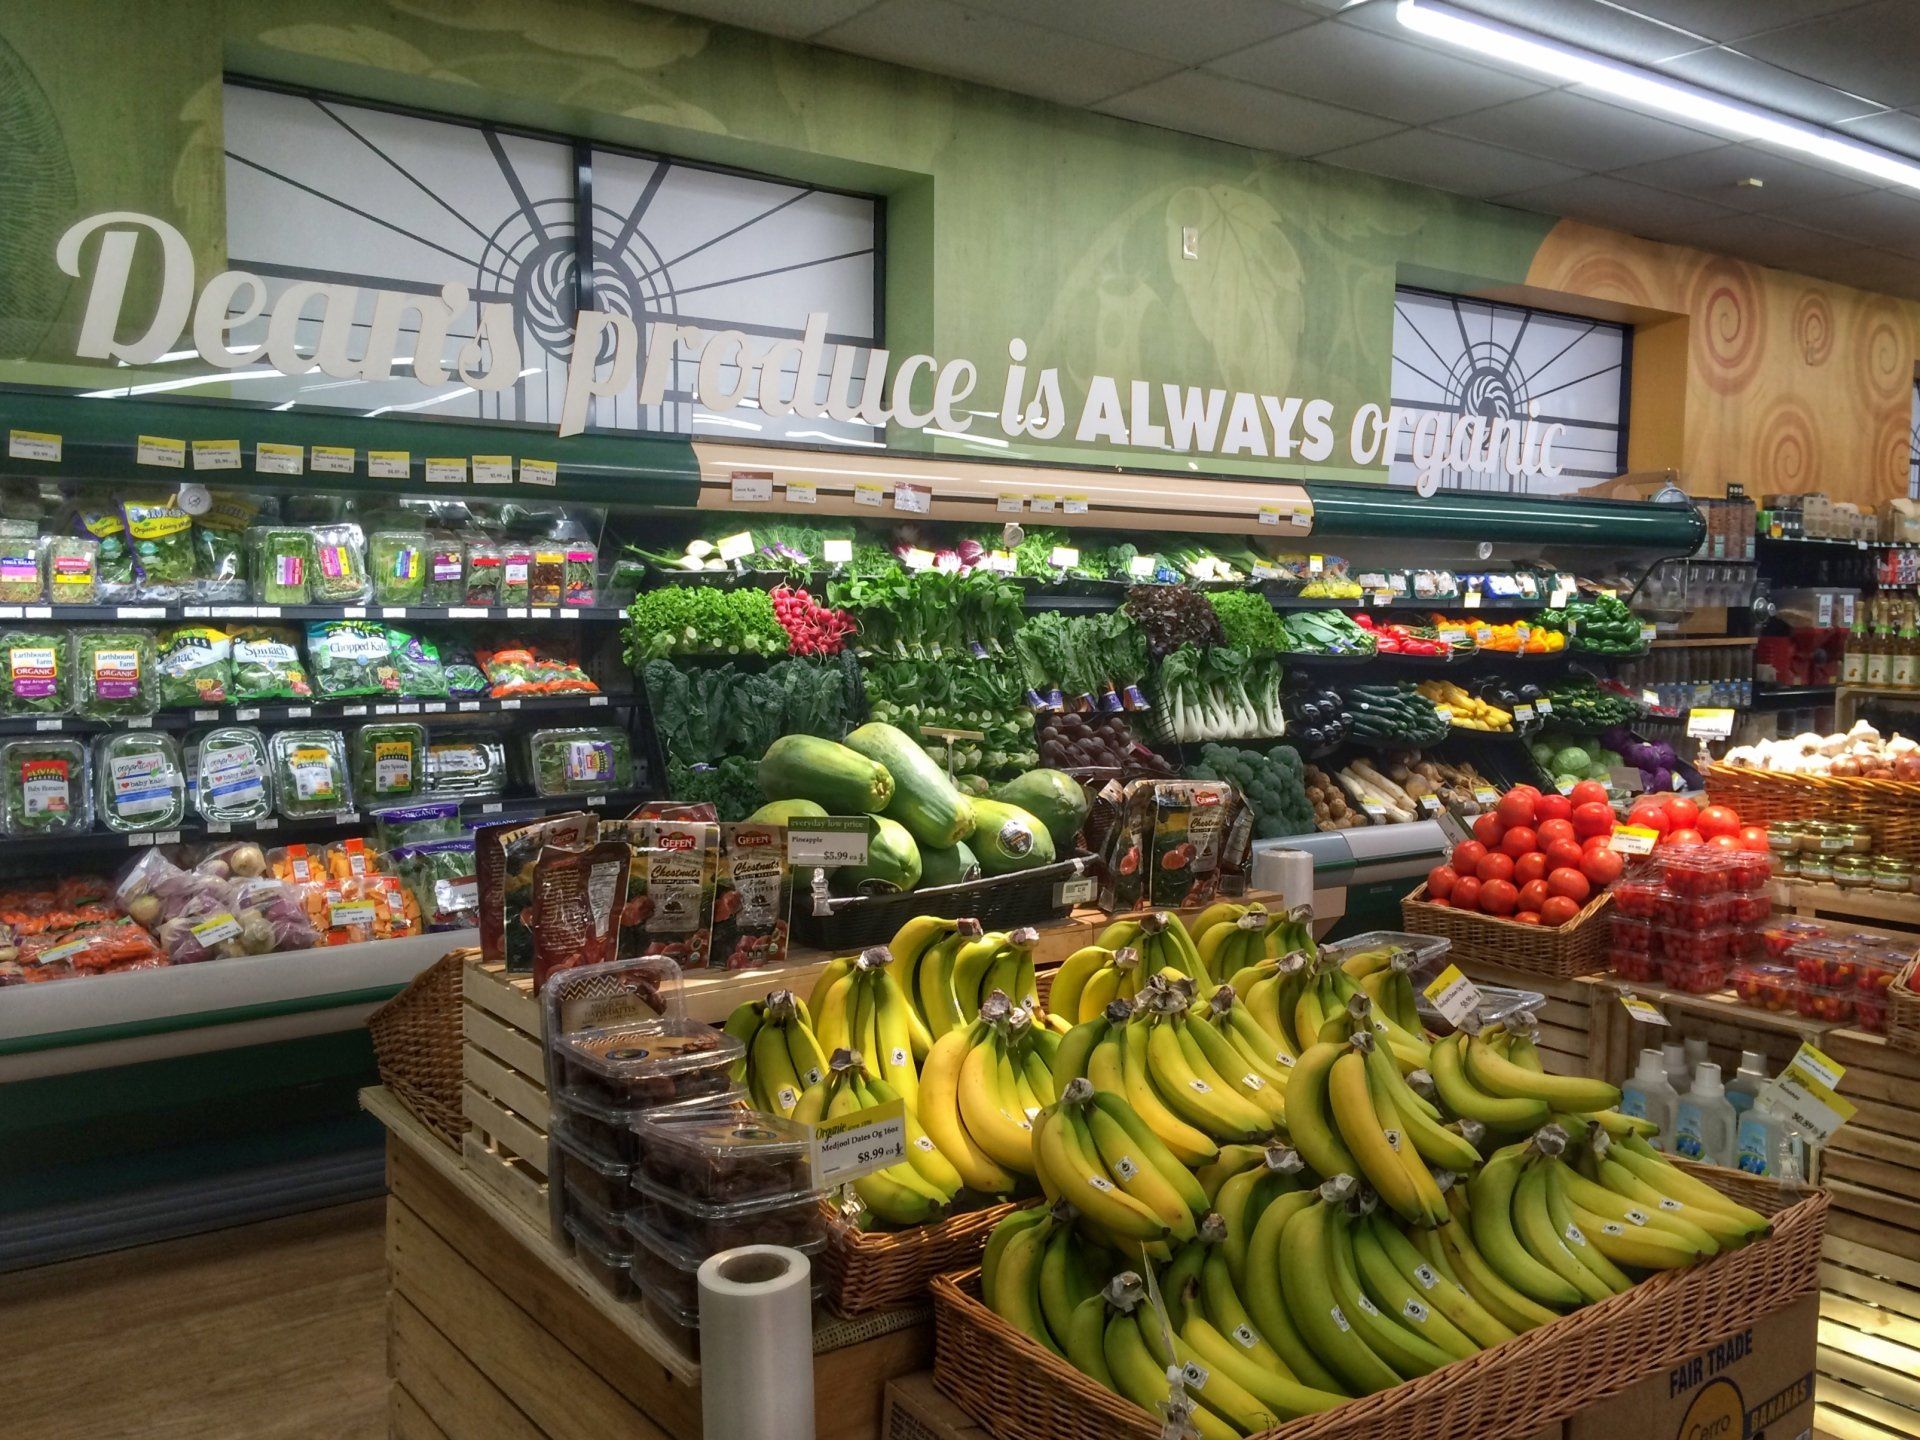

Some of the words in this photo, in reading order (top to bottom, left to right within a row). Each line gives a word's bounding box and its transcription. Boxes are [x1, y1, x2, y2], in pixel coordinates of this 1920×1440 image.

[56, 211, 522, 392] Dean's
[559, 310, 977, 438] produce
[1001, 338, 1065, 440] is
[1075, 375, 1335, 463] ALWAYS
[1351, 399, 1568, 498] organic
[244, 645, 290, 658] Spinach
[330, 642, 370, 654] Chopped
[13, 651, 52, 659] Earthbound
[15, 668, 53, 676] ORGANIC
[223, 772, 240, 781] baby
[130, 778, 148, 788] baby
[790, 819, 826, 829] everyday
[827, 818, 842, 827] low
[842, 819, 864, 830] price
[660, 837, 694, 848] GEFEN
[737, 835, 770, 845] GEFEN
[791, 836, 823, 845] Pineapple
[823, 850, 849, 861] $5.99
[650, 864, 701, 879] Chestnuts
[733, 860, 781, 876] Chestnuts
[815, 1122, 847, 1143] Organic
[821, 1138, 850, 1153] Medjool
[851, 1133, 871, 1144] Dates
[857, 1146, 884, 1164] $8.99
[1669, 1356, 1703, 1400] FAIR
[1707, 1328, 1753, 1376] TRADE
[1689, 1414, 1731, 1440] Cerro
